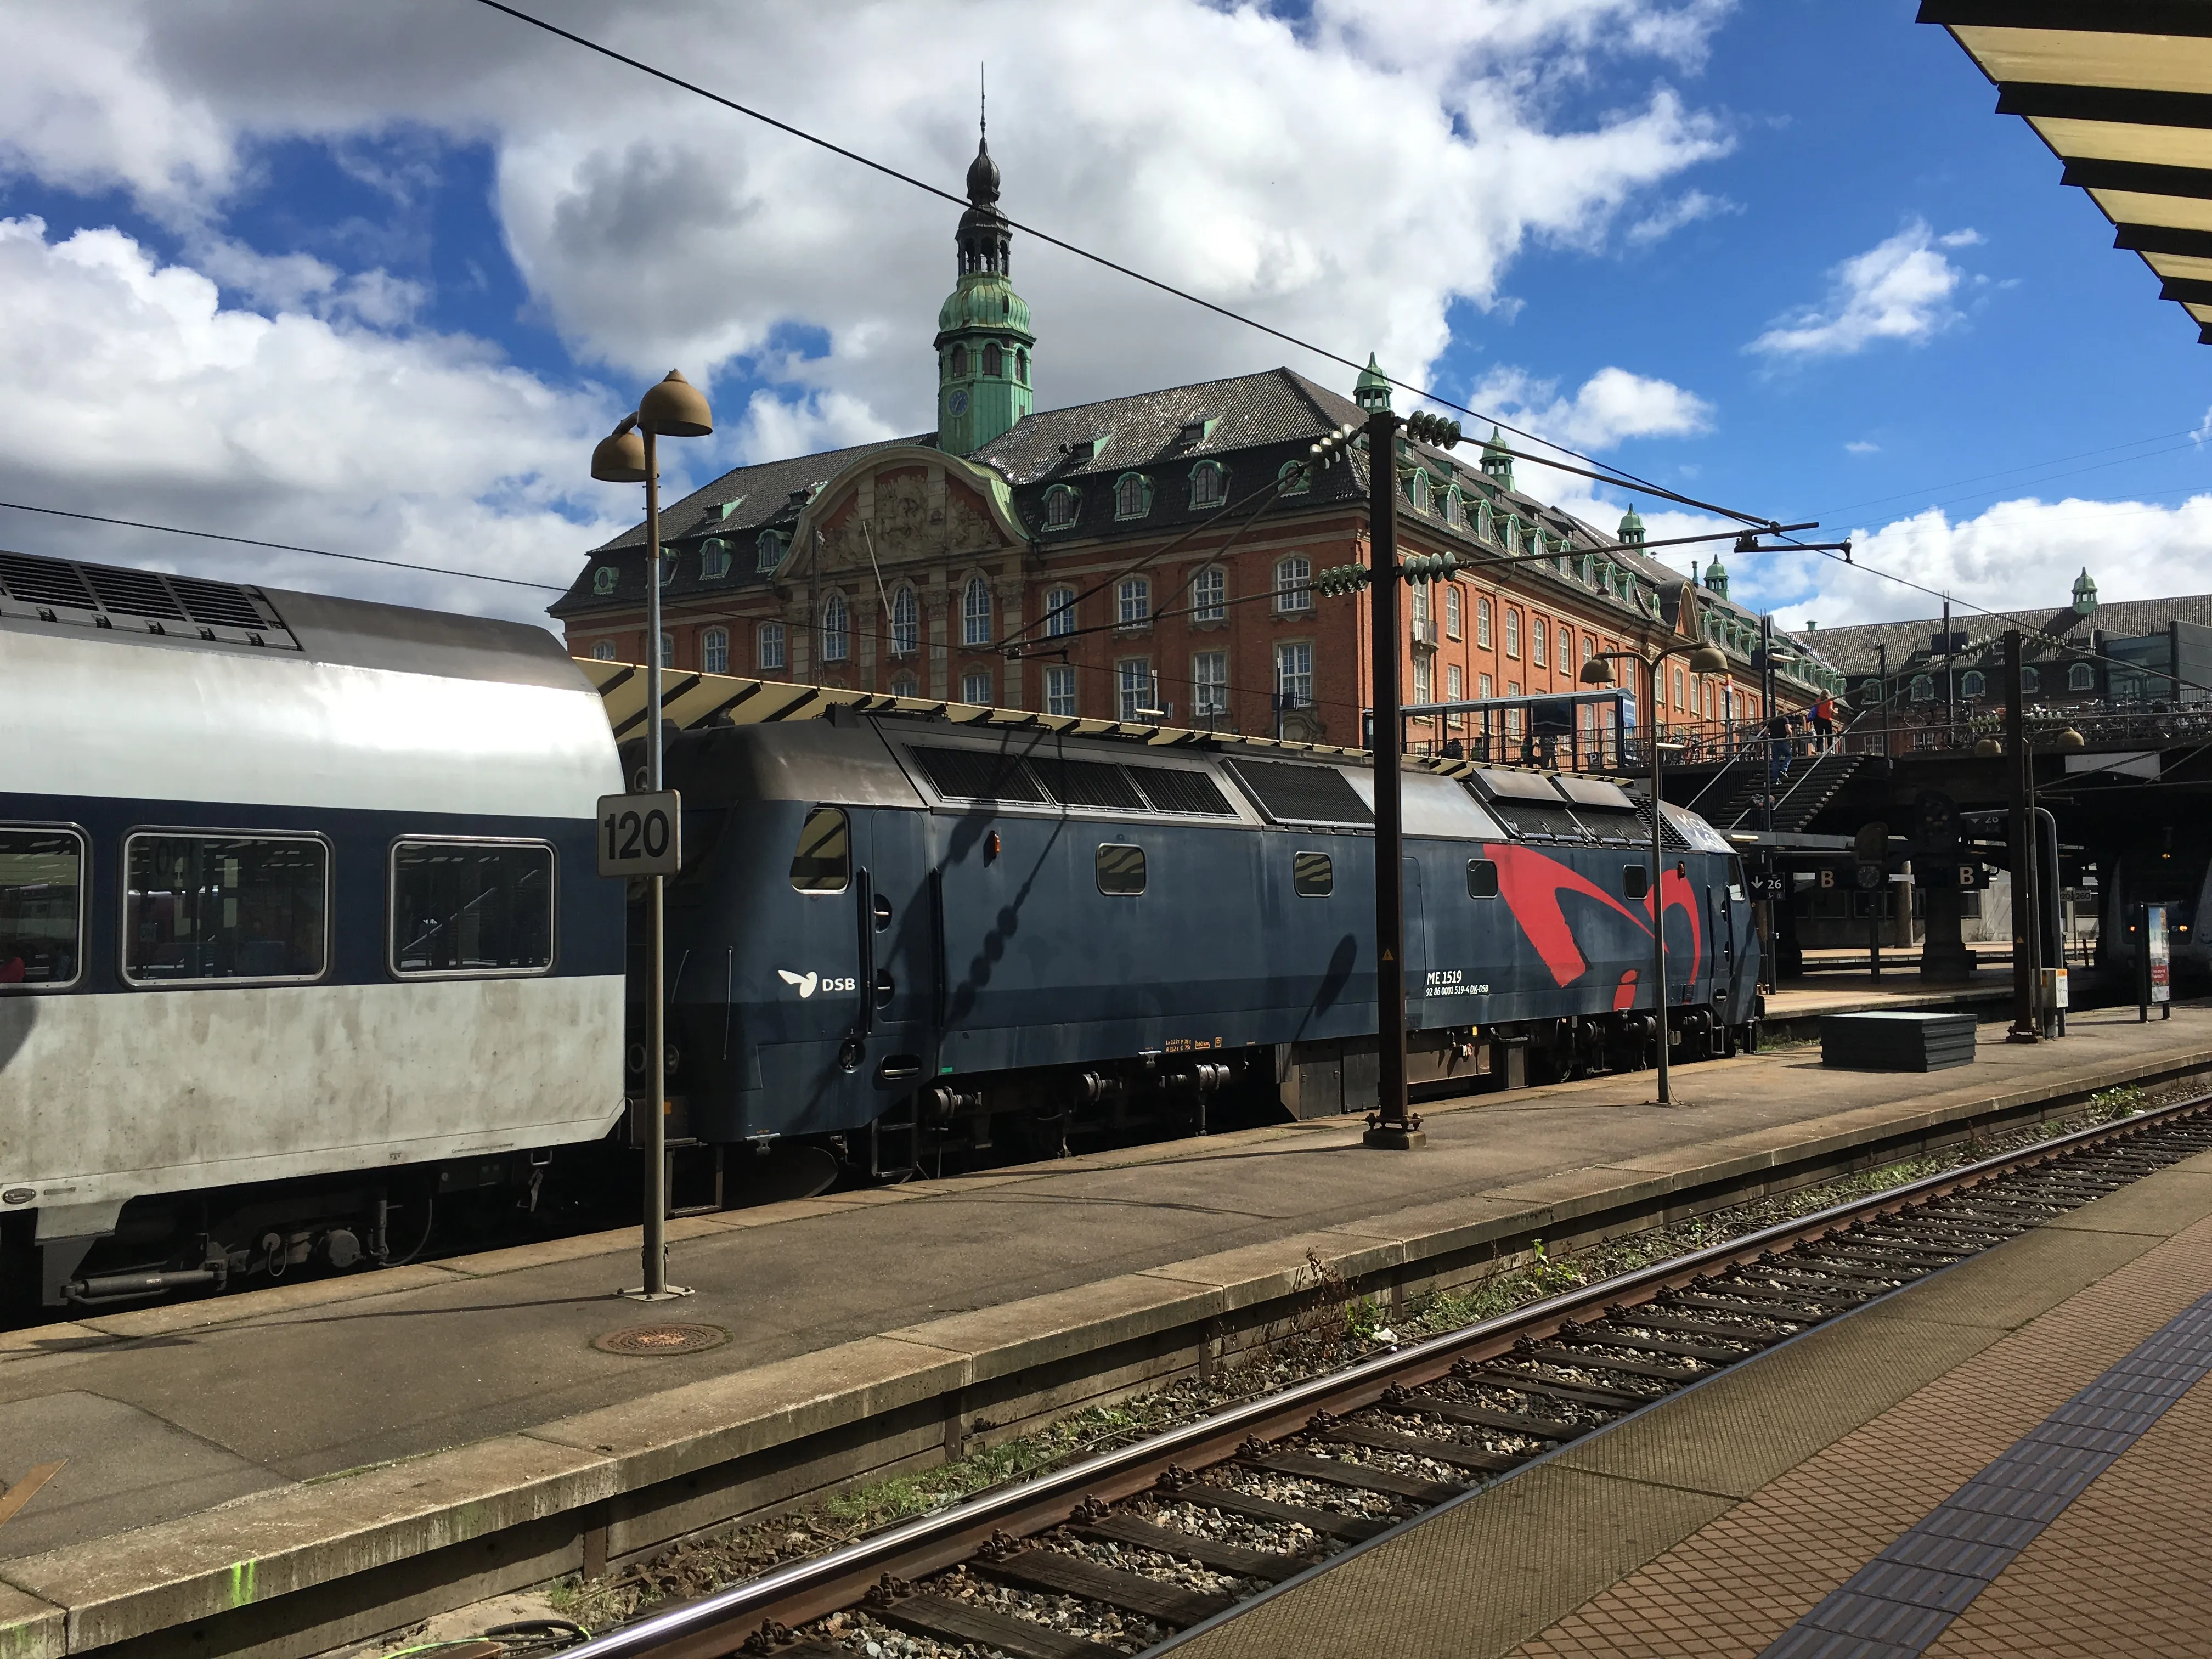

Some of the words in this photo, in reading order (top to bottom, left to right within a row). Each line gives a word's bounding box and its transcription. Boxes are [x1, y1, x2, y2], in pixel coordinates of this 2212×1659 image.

[605, 809, 669, 860] 120
[1821, 871, 1835, 888] B
[1960, 867, 1974, 885] B
[1768, 879, 1782, 889] 26
[822, 978, 856, 991] DSB
[1426, 972, 1441, 985] ME
[1442, 970, 1462, 984] 1519
[1426, 988, 1433, 996] 92
[1434, 987, 1441, 996] 86
[1441, 986, 1454, 995] 0001
[1454, 985, 1469, 994] 519-4
[1470, 984, 1489, 994] DK-DSB
